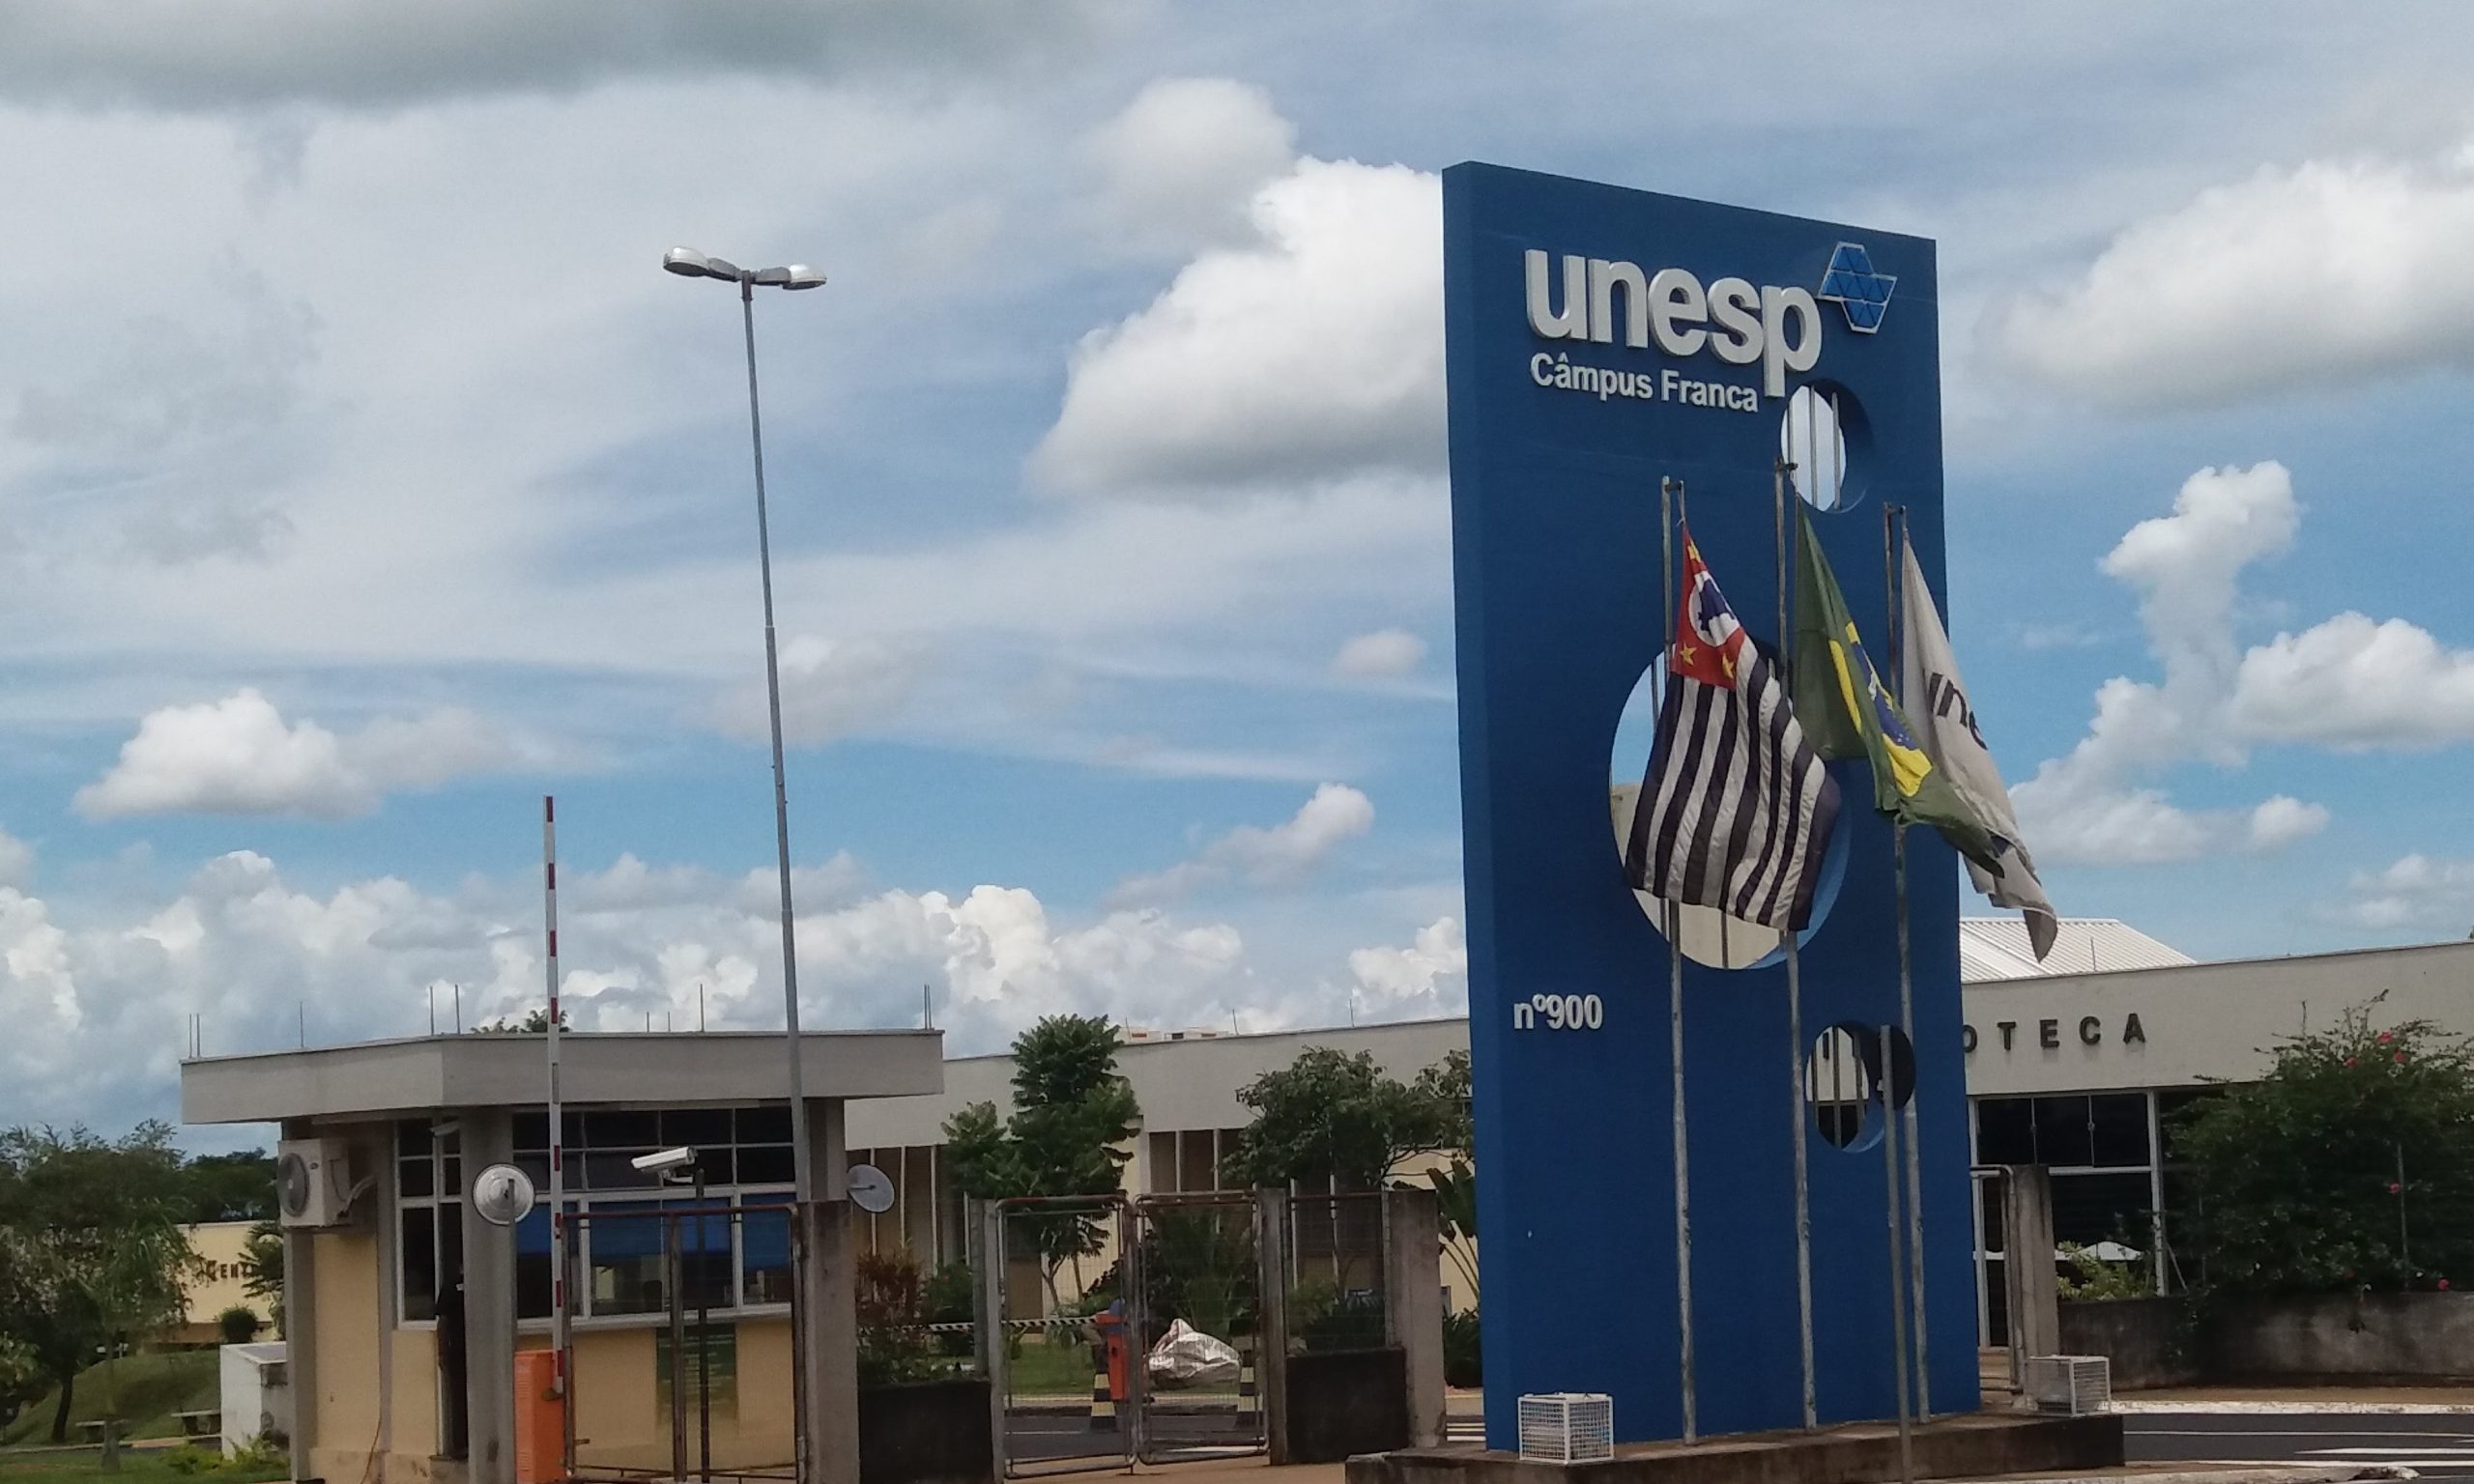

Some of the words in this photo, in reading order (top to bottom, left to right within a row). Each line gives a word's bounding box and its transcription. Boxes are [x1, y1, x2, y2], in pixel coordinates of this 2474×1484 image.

[1525, 249, 1822, 398] unesp
[1530, 352, 1654, 402] Câmpus
[1660, 368, 1759, 413] Franca
